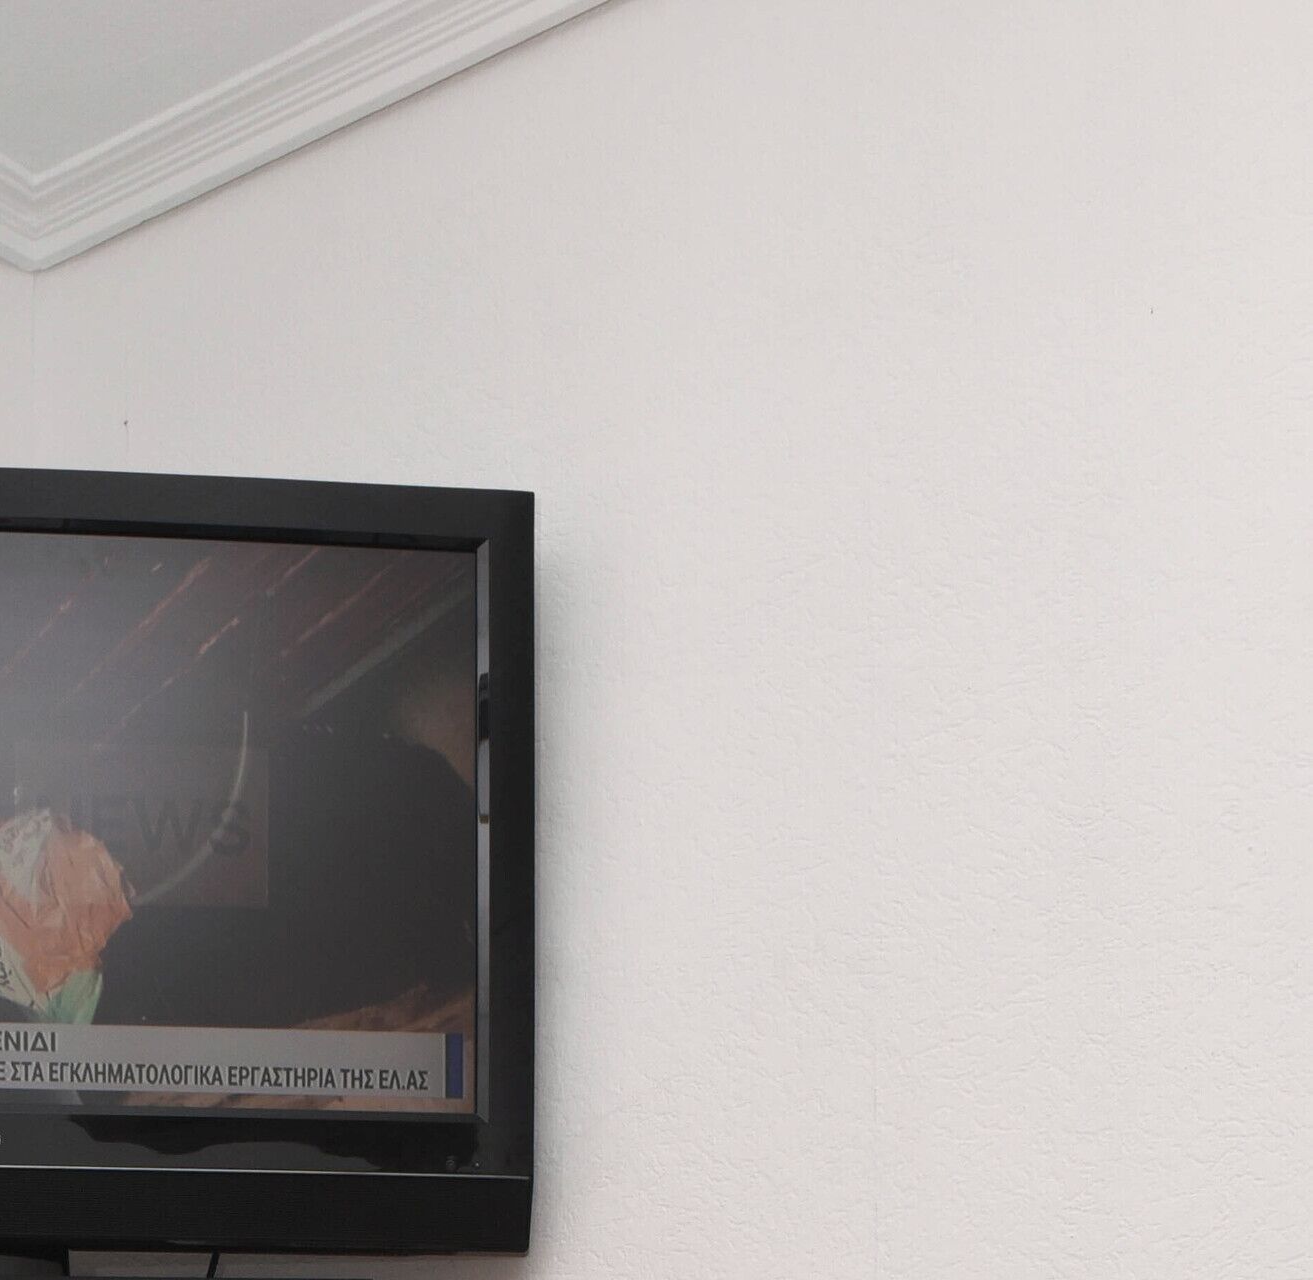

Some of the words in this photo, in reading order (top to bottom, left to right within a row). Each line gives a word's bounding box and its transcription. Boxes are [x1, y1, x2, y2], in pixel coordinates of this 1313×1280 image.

[10, 1061, 44, 1082] ΣΤΑ
[49, 1062, 224, 1086] ΕΓΚΛΗΜΑΤΟΛΟΓΙΚΑ
[227, 1065, 339, 1089] ΕΡΓΑΣΤΗΡΙΑ
[340, 1068, 374, 1090] ΤΗΣ
[379, 1069, 429, 1091] ΕΛ.ΑΣ
